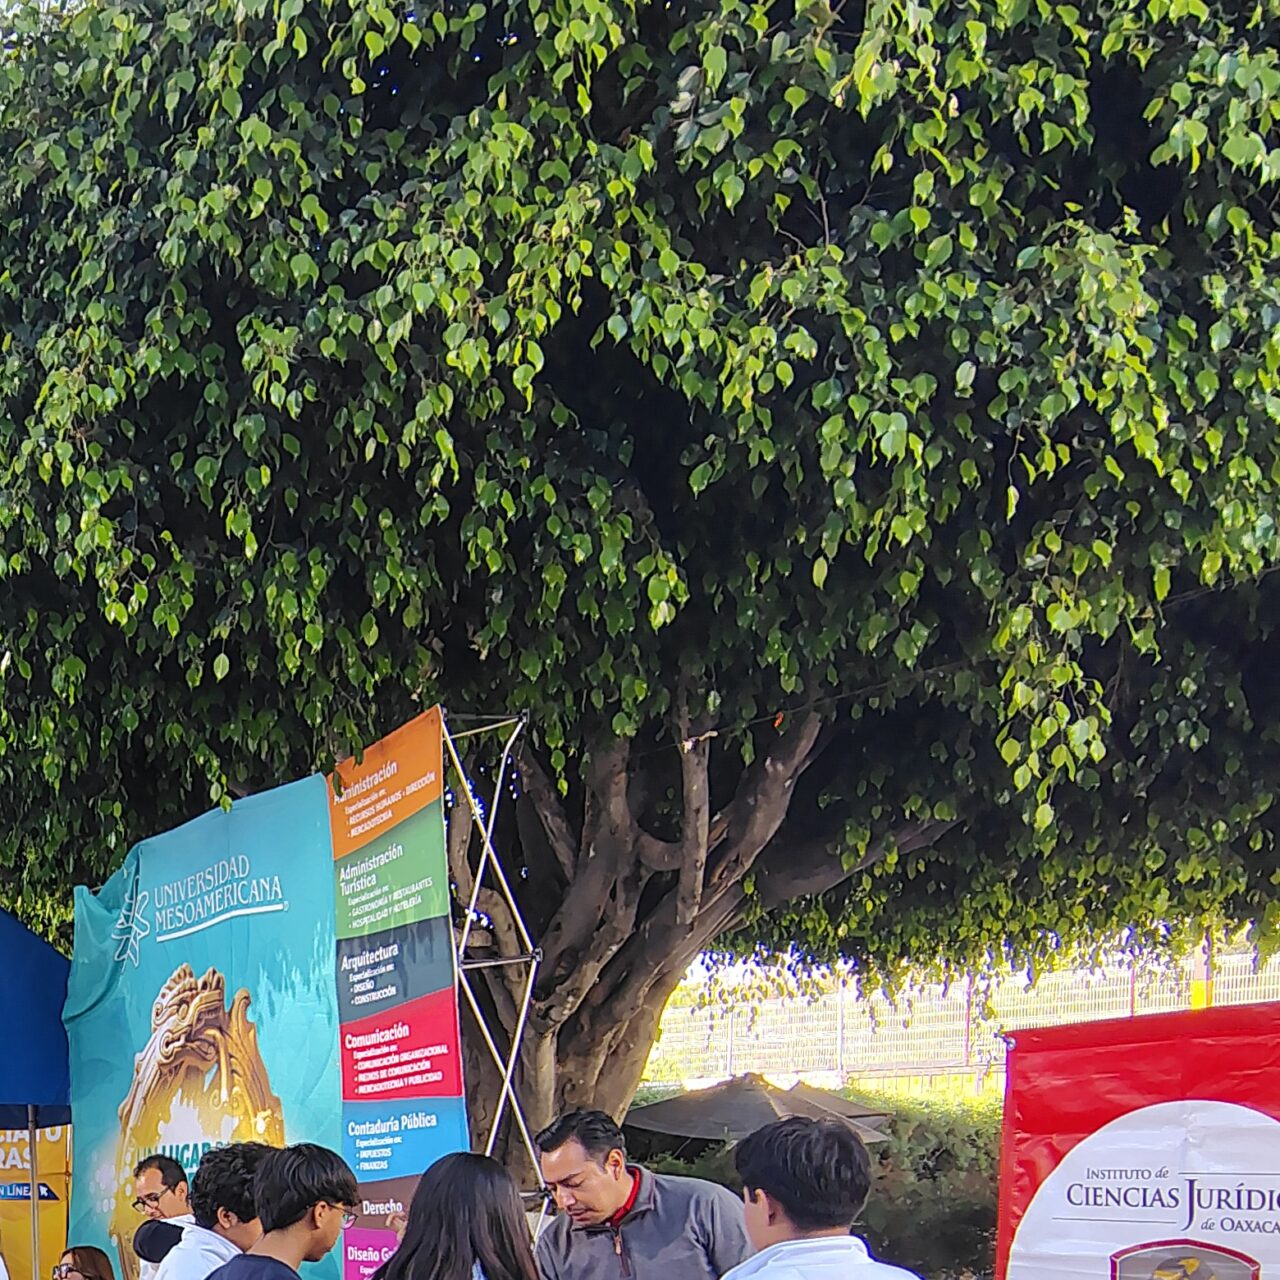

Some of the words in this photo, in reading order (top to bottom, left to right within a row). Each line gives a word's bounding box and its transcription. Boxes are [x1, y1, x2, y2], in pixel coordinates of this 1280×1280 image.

[339, 842, 403, 882] Administración
[154, 854, 250, 908] UNIVERSIDAD
[340, 873, 377, 897] Turística
[155, 875, 283, 932] MESOAMERICANA
[341, 943, 399, 972] Arquitectura
[353, 978, 375, 993] DISEÑO
[354, 984, 397, 1005] CONSTRUCCIÓN
[345, 1021, 409, 1049] Comunicación
[348, 1116, 399, 1136] Contaduría
[401, 1111, 437, 1131] Pública
[360, 1160, 388, 1171] FINANZAS
[1086, 1167, 1152, 1180] INSTITUTO
[1154, 1166, 1170, 1179] de
[6, 1184, 32, 1197] LÍNE
[362, 1198, 403, 1215] Derecho
[1067, 1183, 1180, 1208] CIENCIAS
[1180, 1178, 1280, 1231] JURÍDI
[1200, 1217, 1216, 1231] de
[1220, 1217, 1280, 1234] OAXACA
[347, 1246, 380, 1261] Diseño
